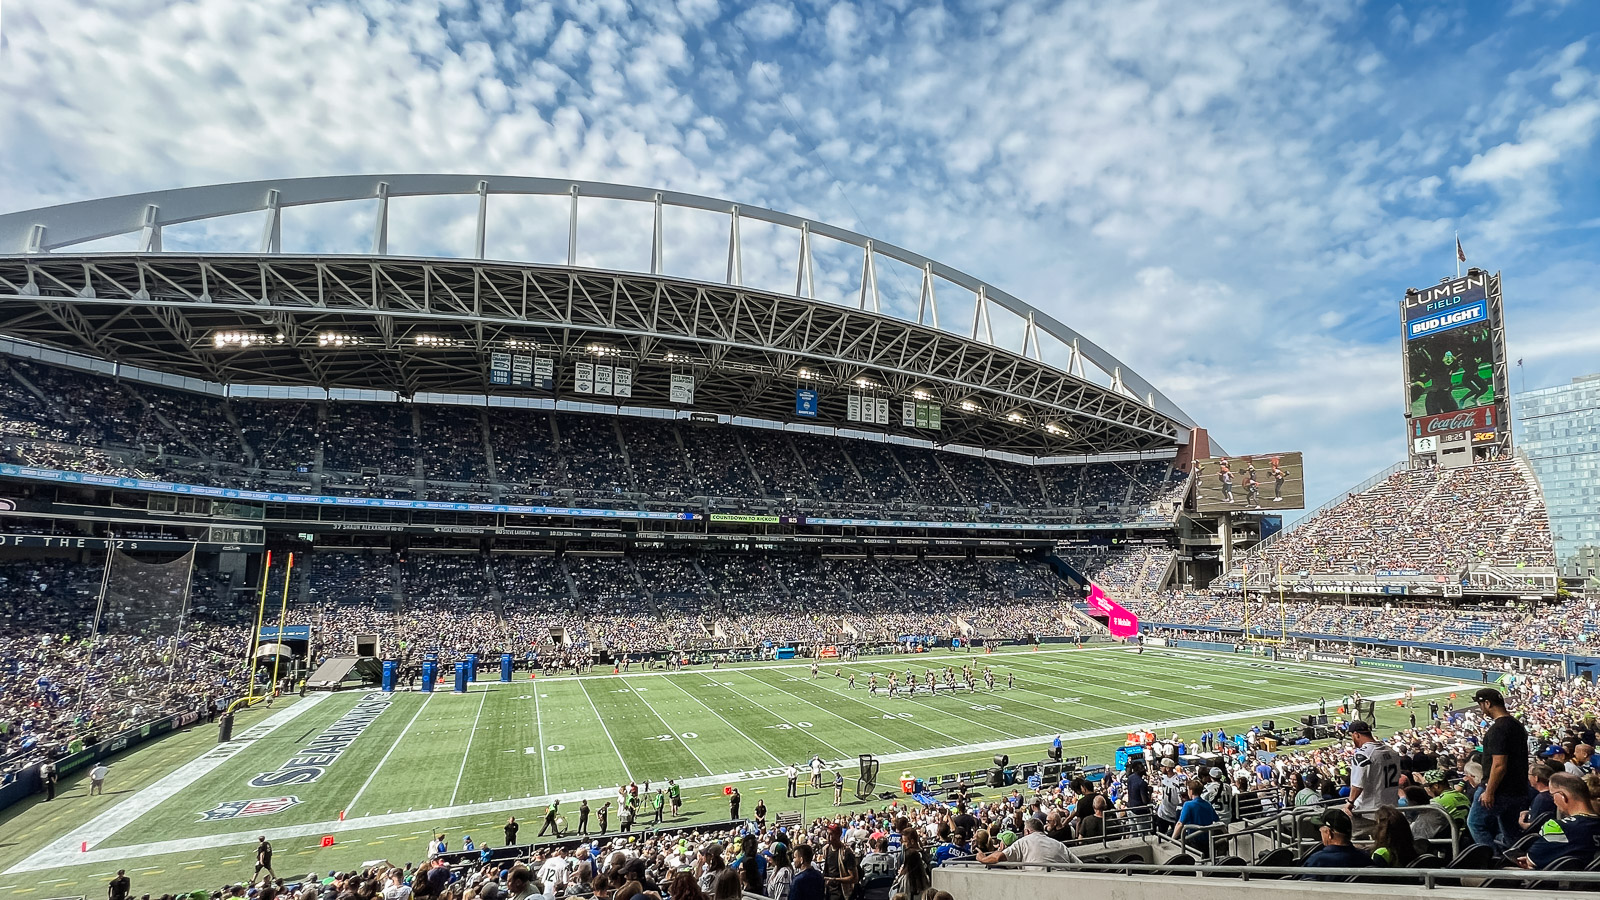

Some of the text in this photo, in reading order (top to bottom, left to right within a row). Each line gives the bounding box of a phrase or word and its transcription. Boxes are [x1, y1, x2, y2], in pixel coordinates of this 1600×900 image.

[1406, 274, 1484, 308] LUMEN
[1426, 296, 1461, 312] FIELD
[1412, 306, 1480, 334] BUD LIGHT
[1427, 410, 1475, 432] Coca-Cola
[44, 538, 85, 548] THE
[1118, 618, 1131, 626] Mobile
[1312, 655, 1349, 663] SEAHAWK
[773, 722, 813, 730] 30
[657, 732, 698, 741] 20
[248, 701, 393, 788] SEAHAWKS
[524, 744, 566, 754] 10
[1384, 764, 1399, 788] 12
[873, 864, 888, 873] 54
[546, 869, 556, 882] 12
